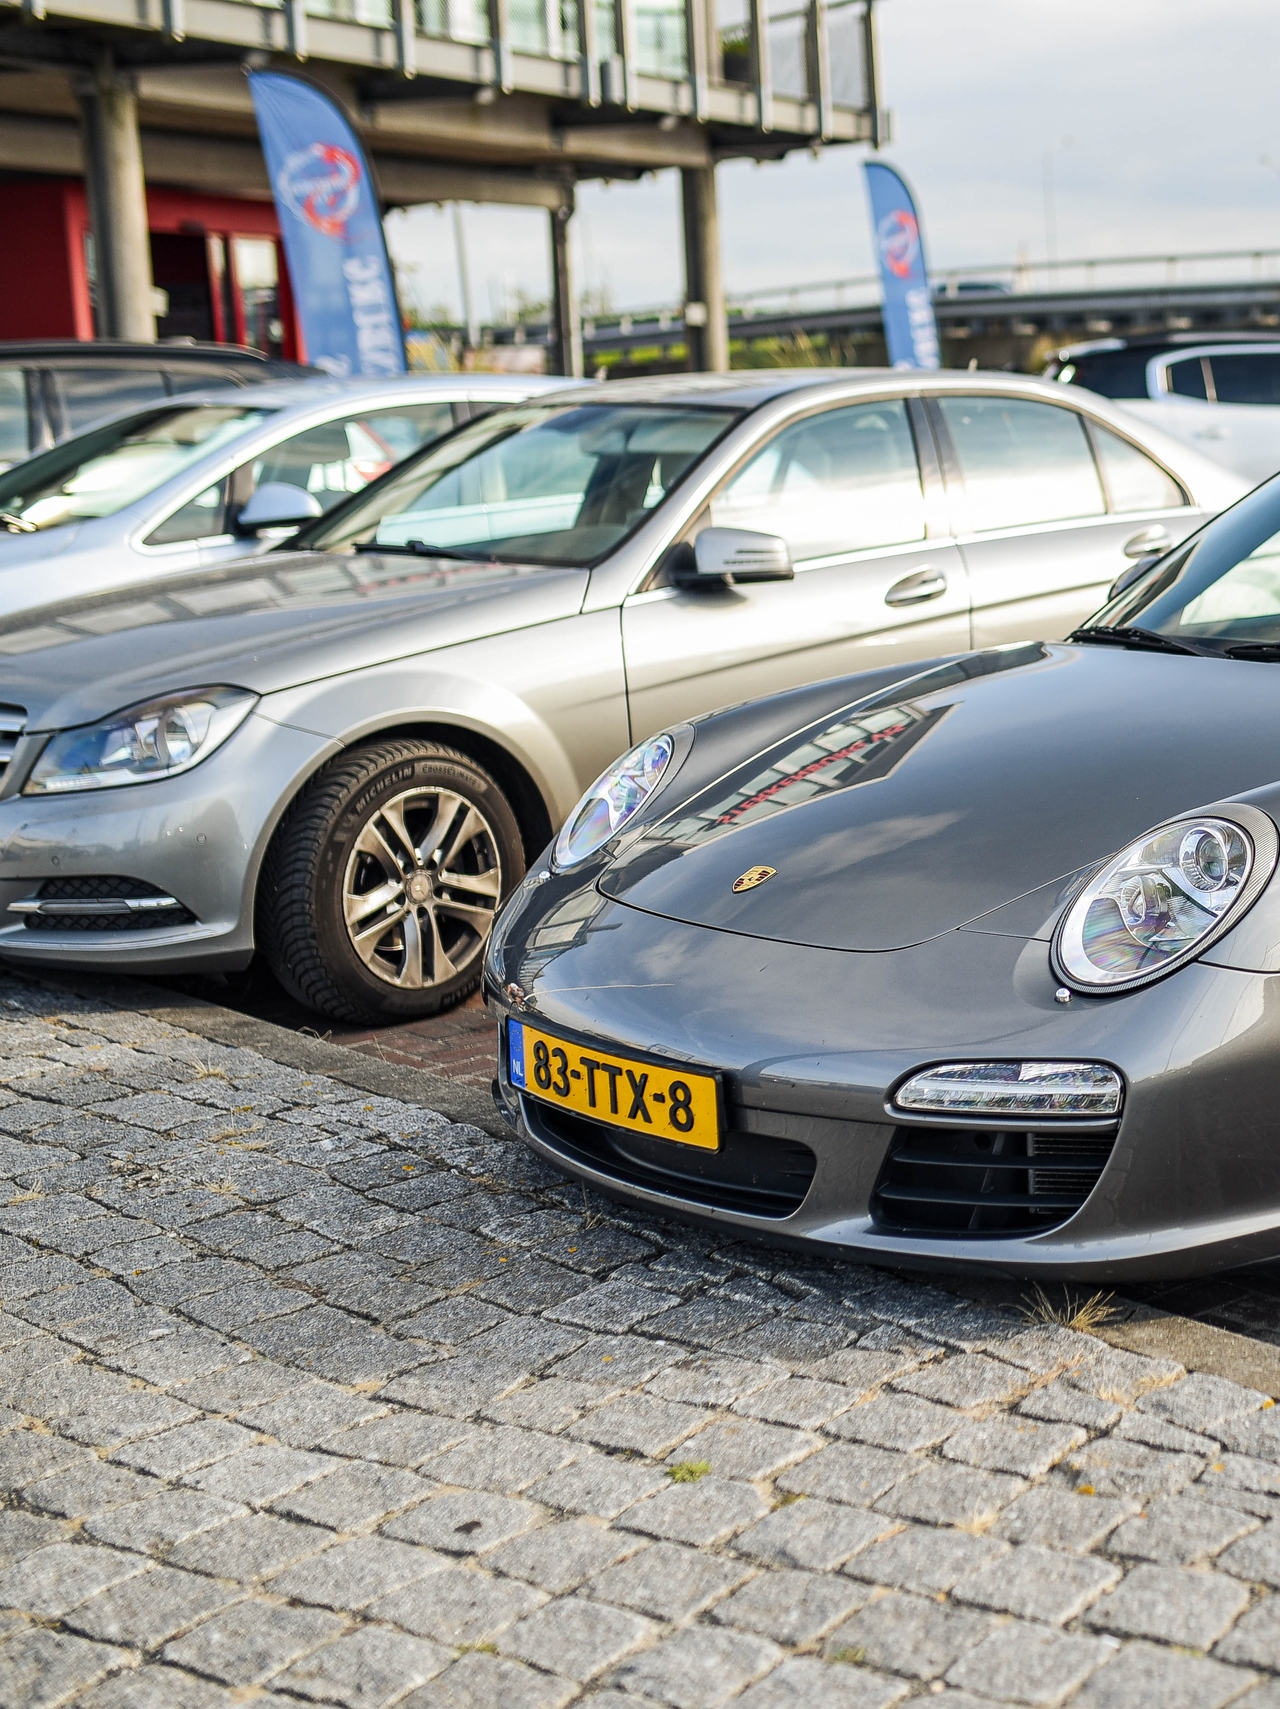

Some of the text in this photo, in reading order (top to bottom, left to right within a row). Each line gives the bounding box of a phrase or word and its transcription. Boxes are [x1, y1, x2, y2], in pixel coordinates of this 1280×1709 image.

[355, 764, 413, 813] MICHELIN
[512, 1040, 694, 1132] NL 83-TTX-8
